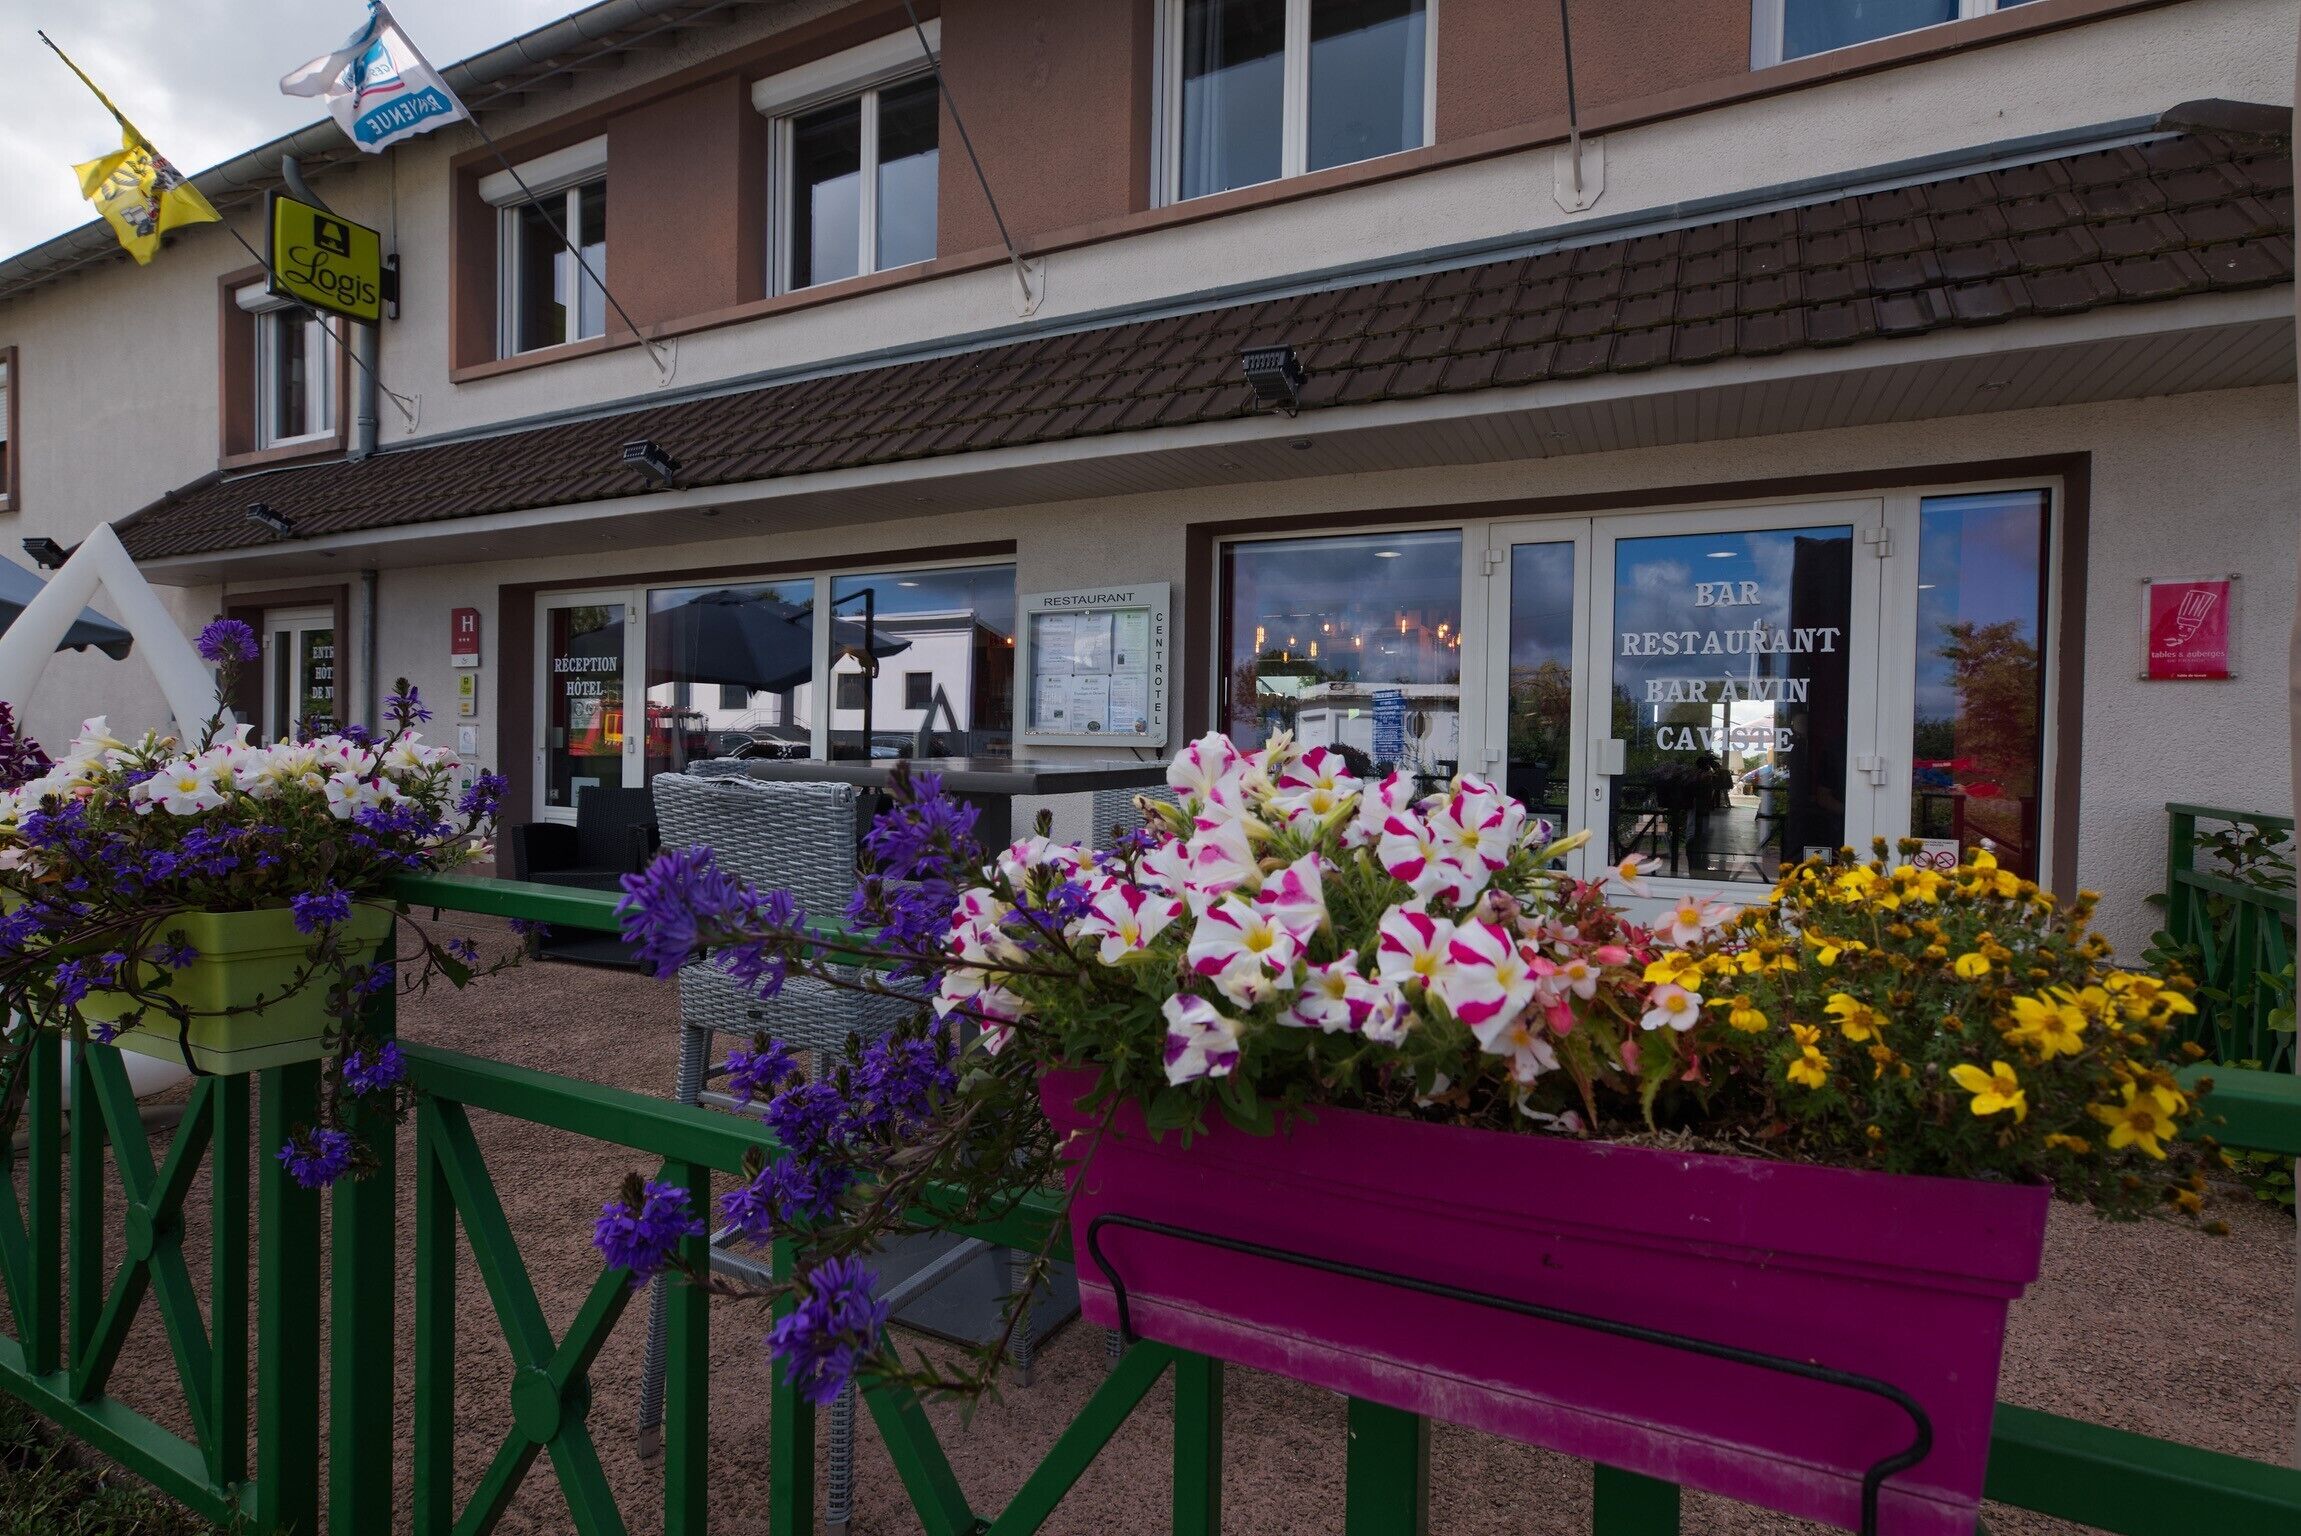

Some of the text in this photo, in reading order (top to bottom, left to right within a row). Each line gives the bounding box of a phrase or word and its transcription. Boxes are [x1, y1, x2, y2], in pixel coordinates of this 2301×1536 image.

[284, 244, 375, 306] Logis
[1043, 592, 1135, 607] RESTAURANT
[1694, 580, 1761, 608] BAR
[462, 615, 474, 632] H
[1621, 627, 1841, 656] RESTAURANT
[313, 646, 335, 659] ENTR
[2151, 650, 2176, 659] tables
[2186, 650, 2225, 658] auberges
[315, 663, 334, 680] HÔT
[554, 653, 617, 672] RÉCEPTION
[1154, 613, 1163, 725] CENTROTEL
[312, 686, 323, 699] DE
[566, 676, 604, 696] HÔTEL
[1645, 670, 1810, 703] BAR À VIN
[1656, 726, 1794, 753] CAVISTE
